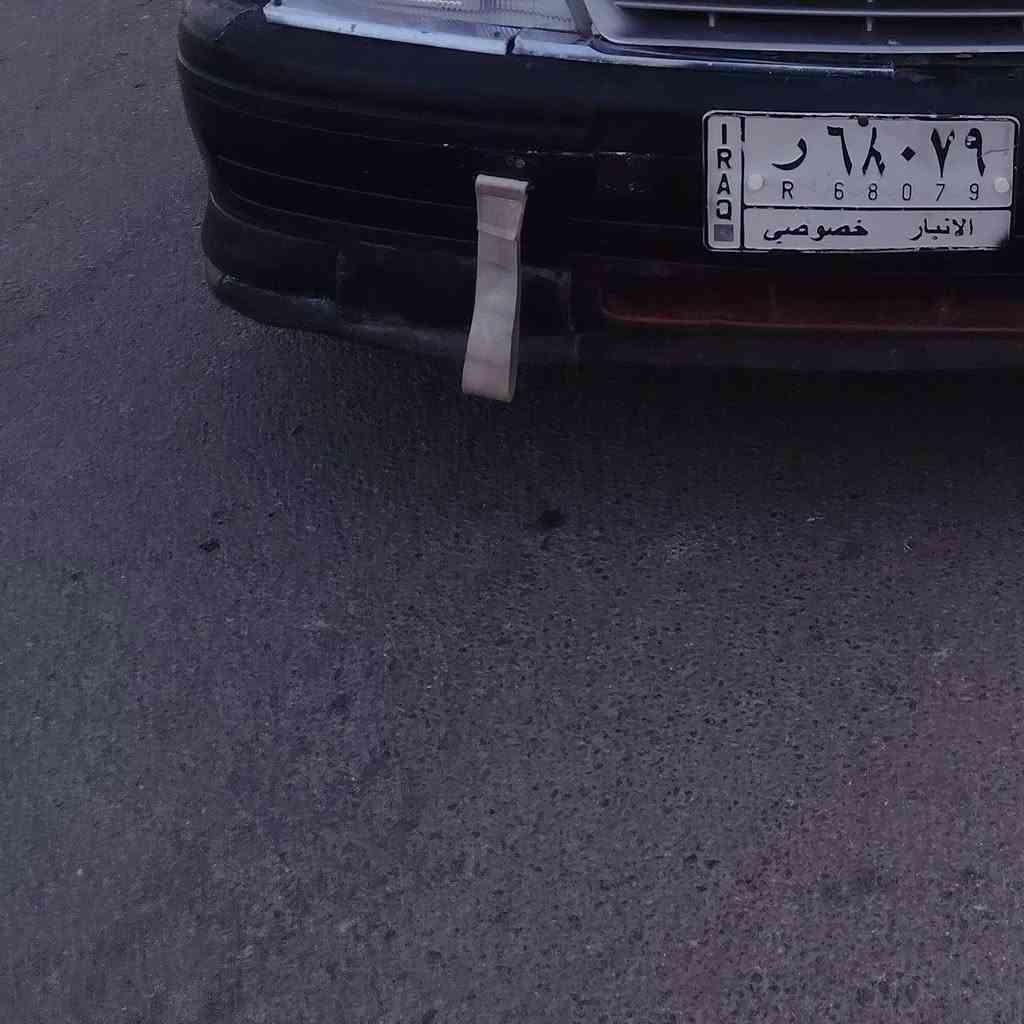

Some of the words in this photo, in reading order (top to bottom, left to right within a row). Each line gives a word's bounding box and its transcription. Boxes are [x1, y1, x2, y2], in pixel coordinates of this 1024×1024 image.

[715, 123, 733, 222] IRAQ
[781, 180, 796, 200] R
[909, 217, 974, 242] الانبار
